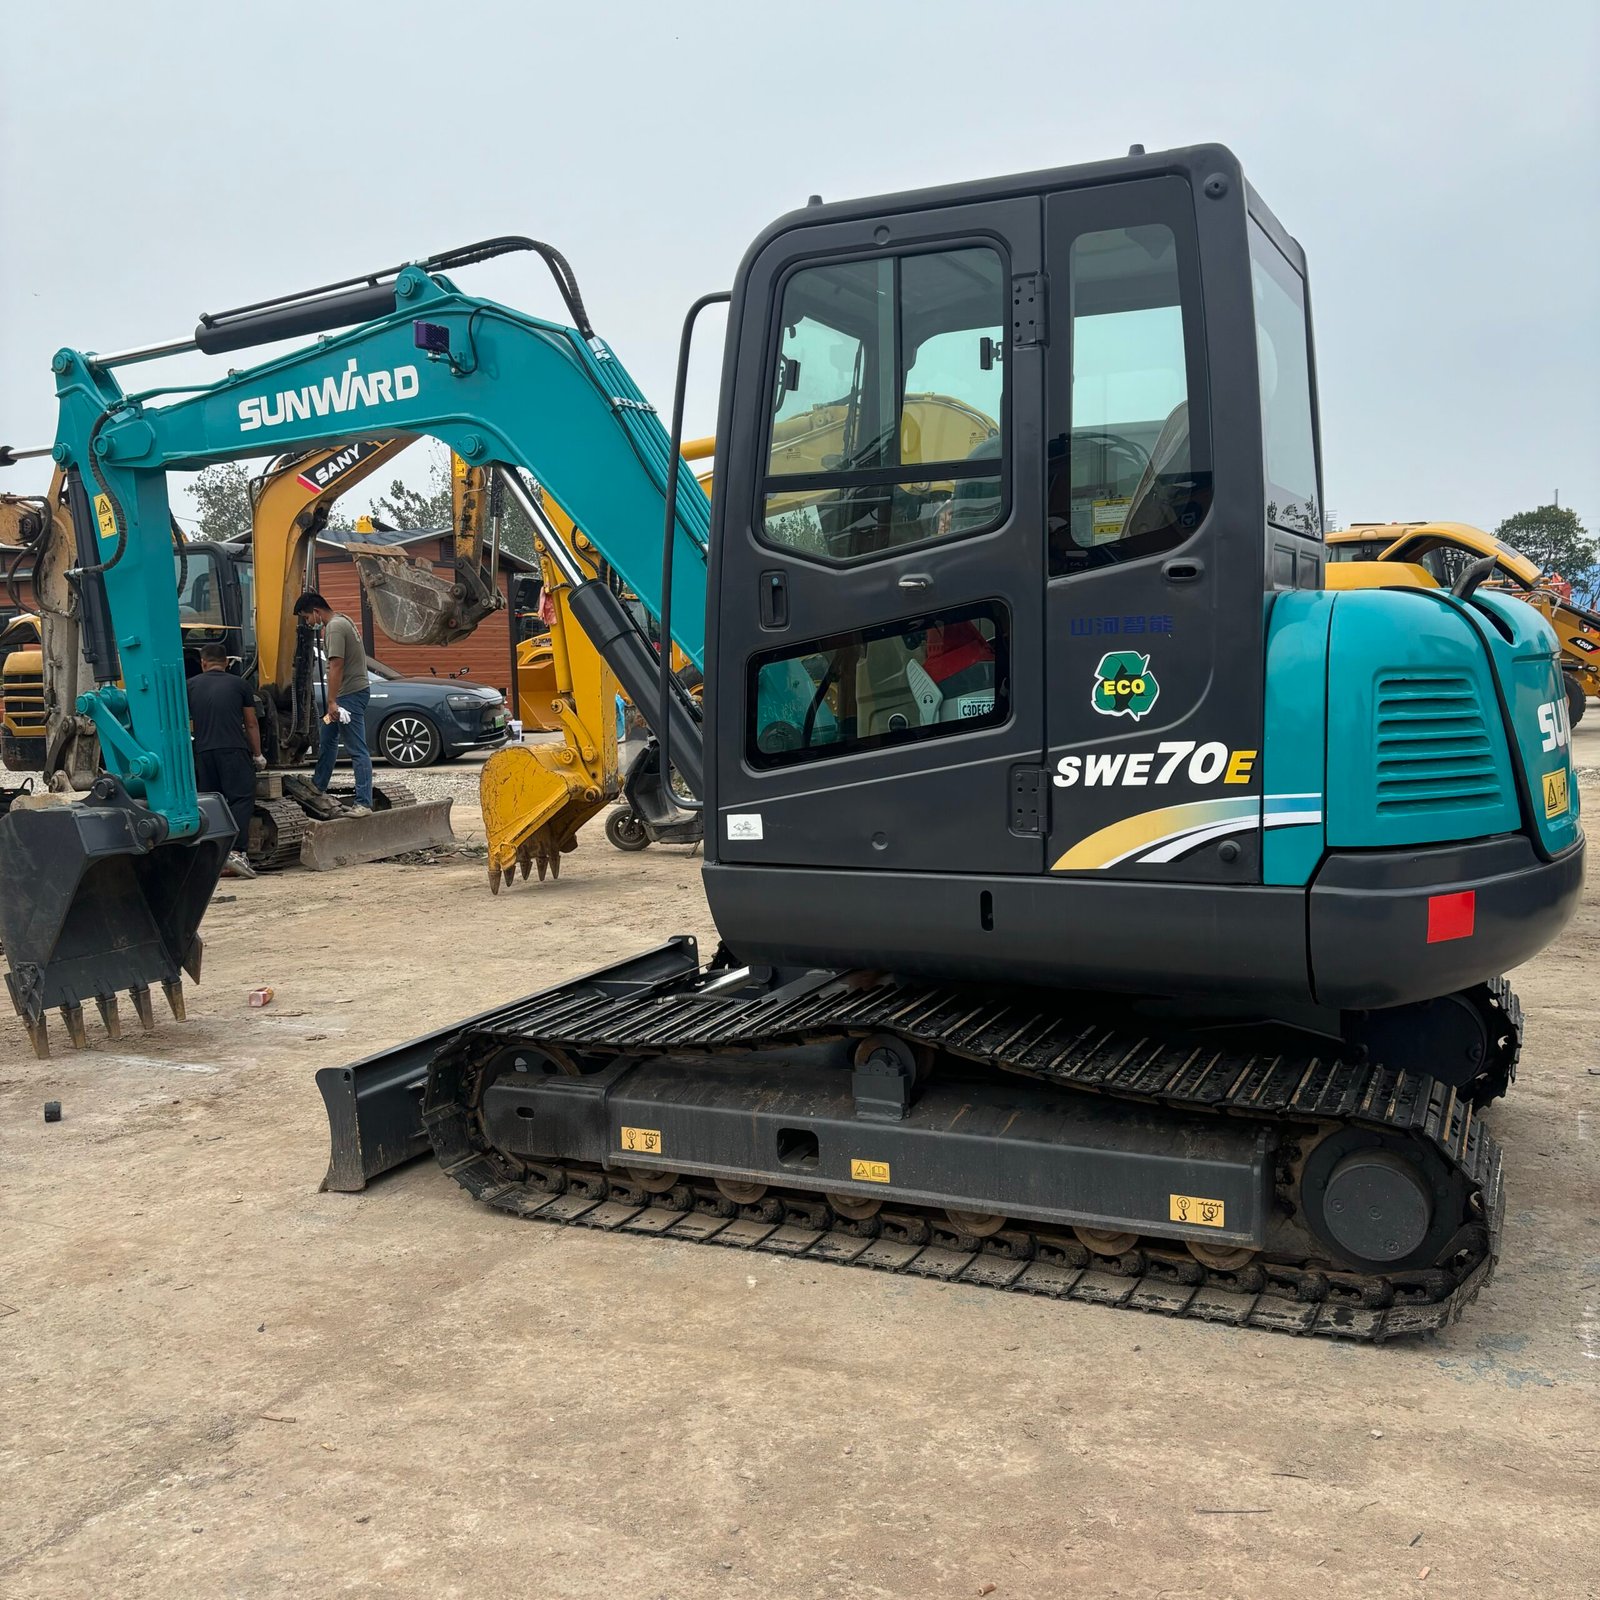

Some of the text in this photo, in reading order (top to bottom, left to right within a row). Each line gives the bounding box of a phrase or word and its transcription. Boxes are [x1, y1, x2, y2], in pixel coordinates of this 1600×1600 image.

[238, 358, 419, 431] SUNWARD
[315, 443, 360, 484] SANY
[1071, 615, 1174, 636] 山河智能
[1103, 678, 1146, 696] ECO
